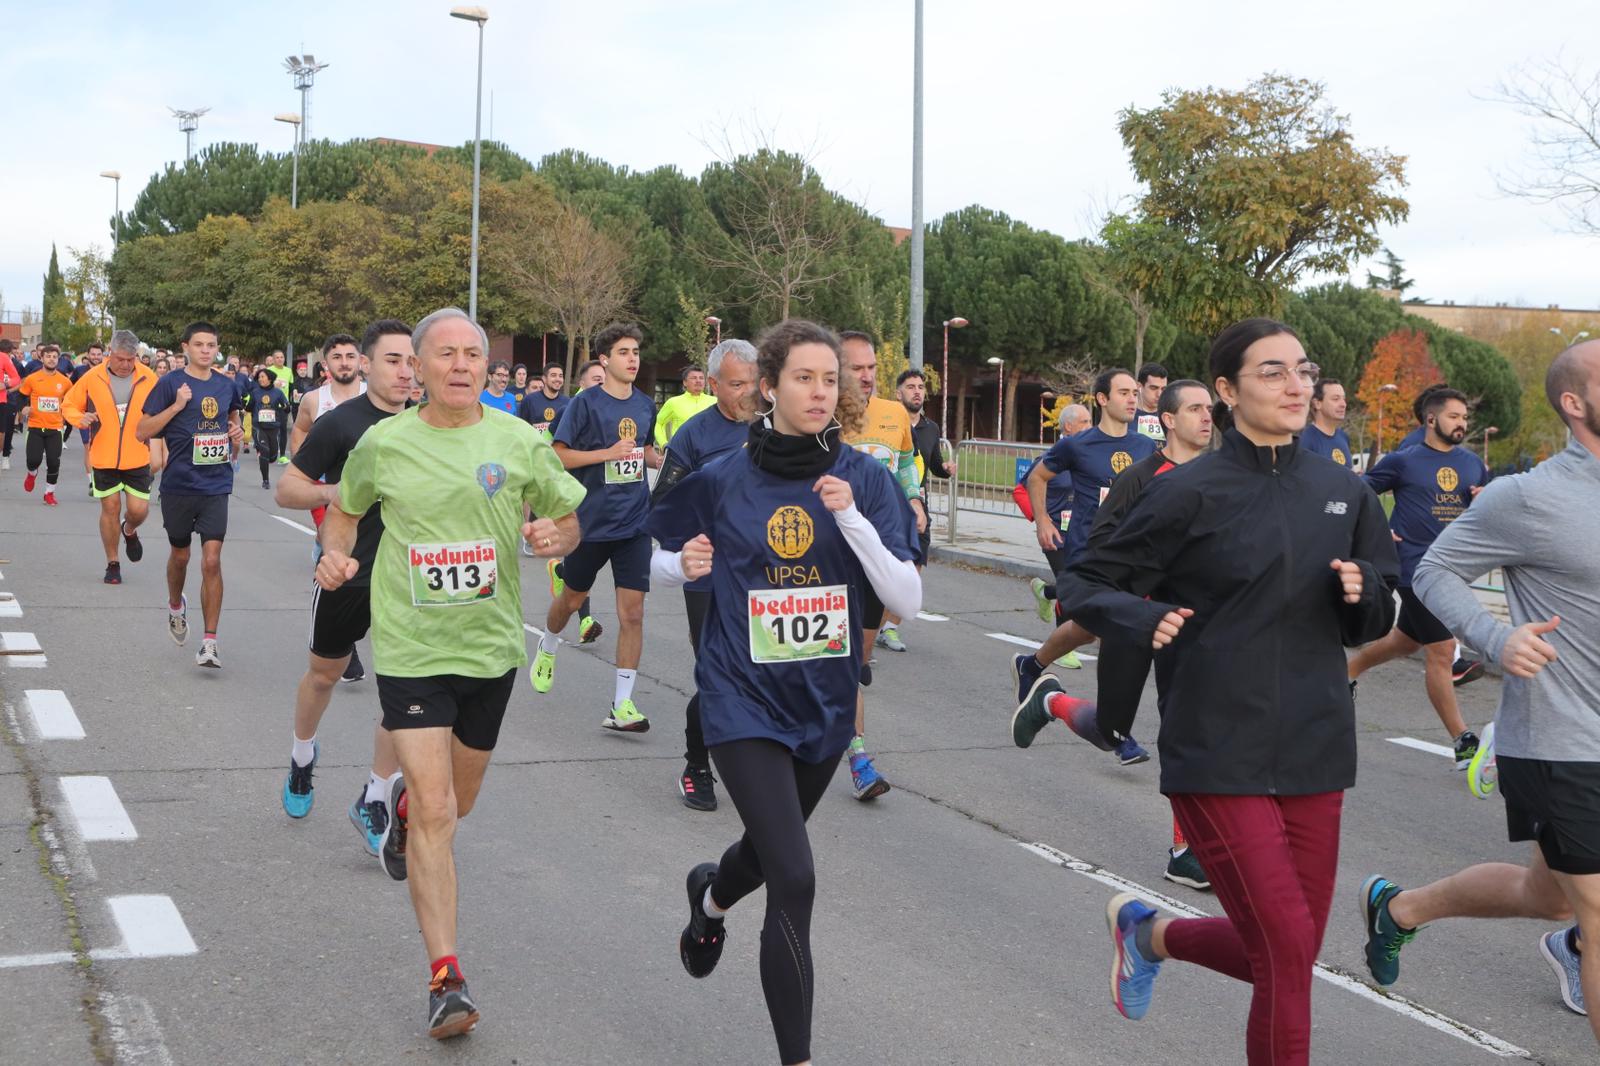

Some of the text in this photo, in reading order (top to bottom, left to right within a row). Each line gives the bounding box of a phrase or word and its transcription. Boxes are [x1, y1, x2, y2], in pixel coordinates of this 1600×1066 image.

[197, 421, 221, 430] UPSA
[1148, 424, 1161, 434] 83
[201, 446, 224, 458] 332
[614, 460, 638, 475] 129
[1435, 493, 1463, 504] UPSA
[410, 544, 495, 566] bedunia
[427, 564, 481, 591] 313
[765, 565, 822, 586] UPSA
[750, 592, 846, 617] bedunia
[771, 614, 829, 644] 102
